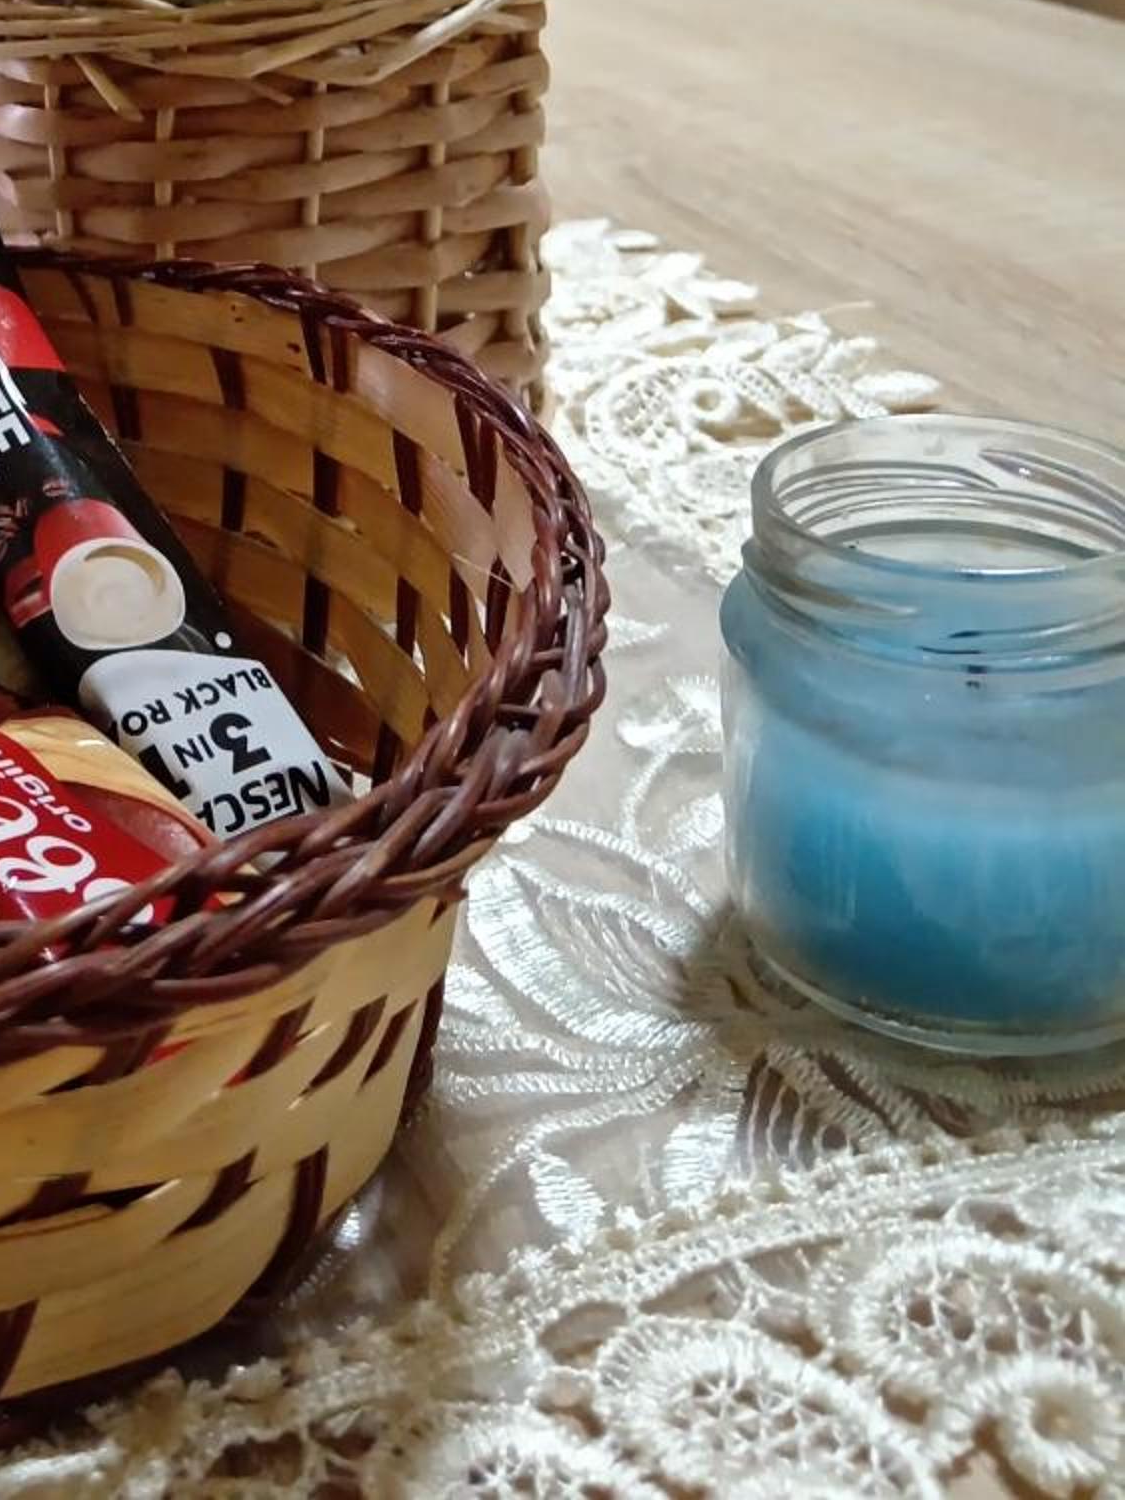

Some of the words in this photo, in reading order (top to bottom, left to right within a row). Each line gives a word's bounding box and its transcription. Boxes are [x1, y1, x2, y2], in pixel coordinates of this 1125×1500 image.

[173, 667, 272, 714] BLACK
[172, 734, 215, 768] IN
[209, 712, 271, 774] 3
[194, 760, 331, 834] NESCA
